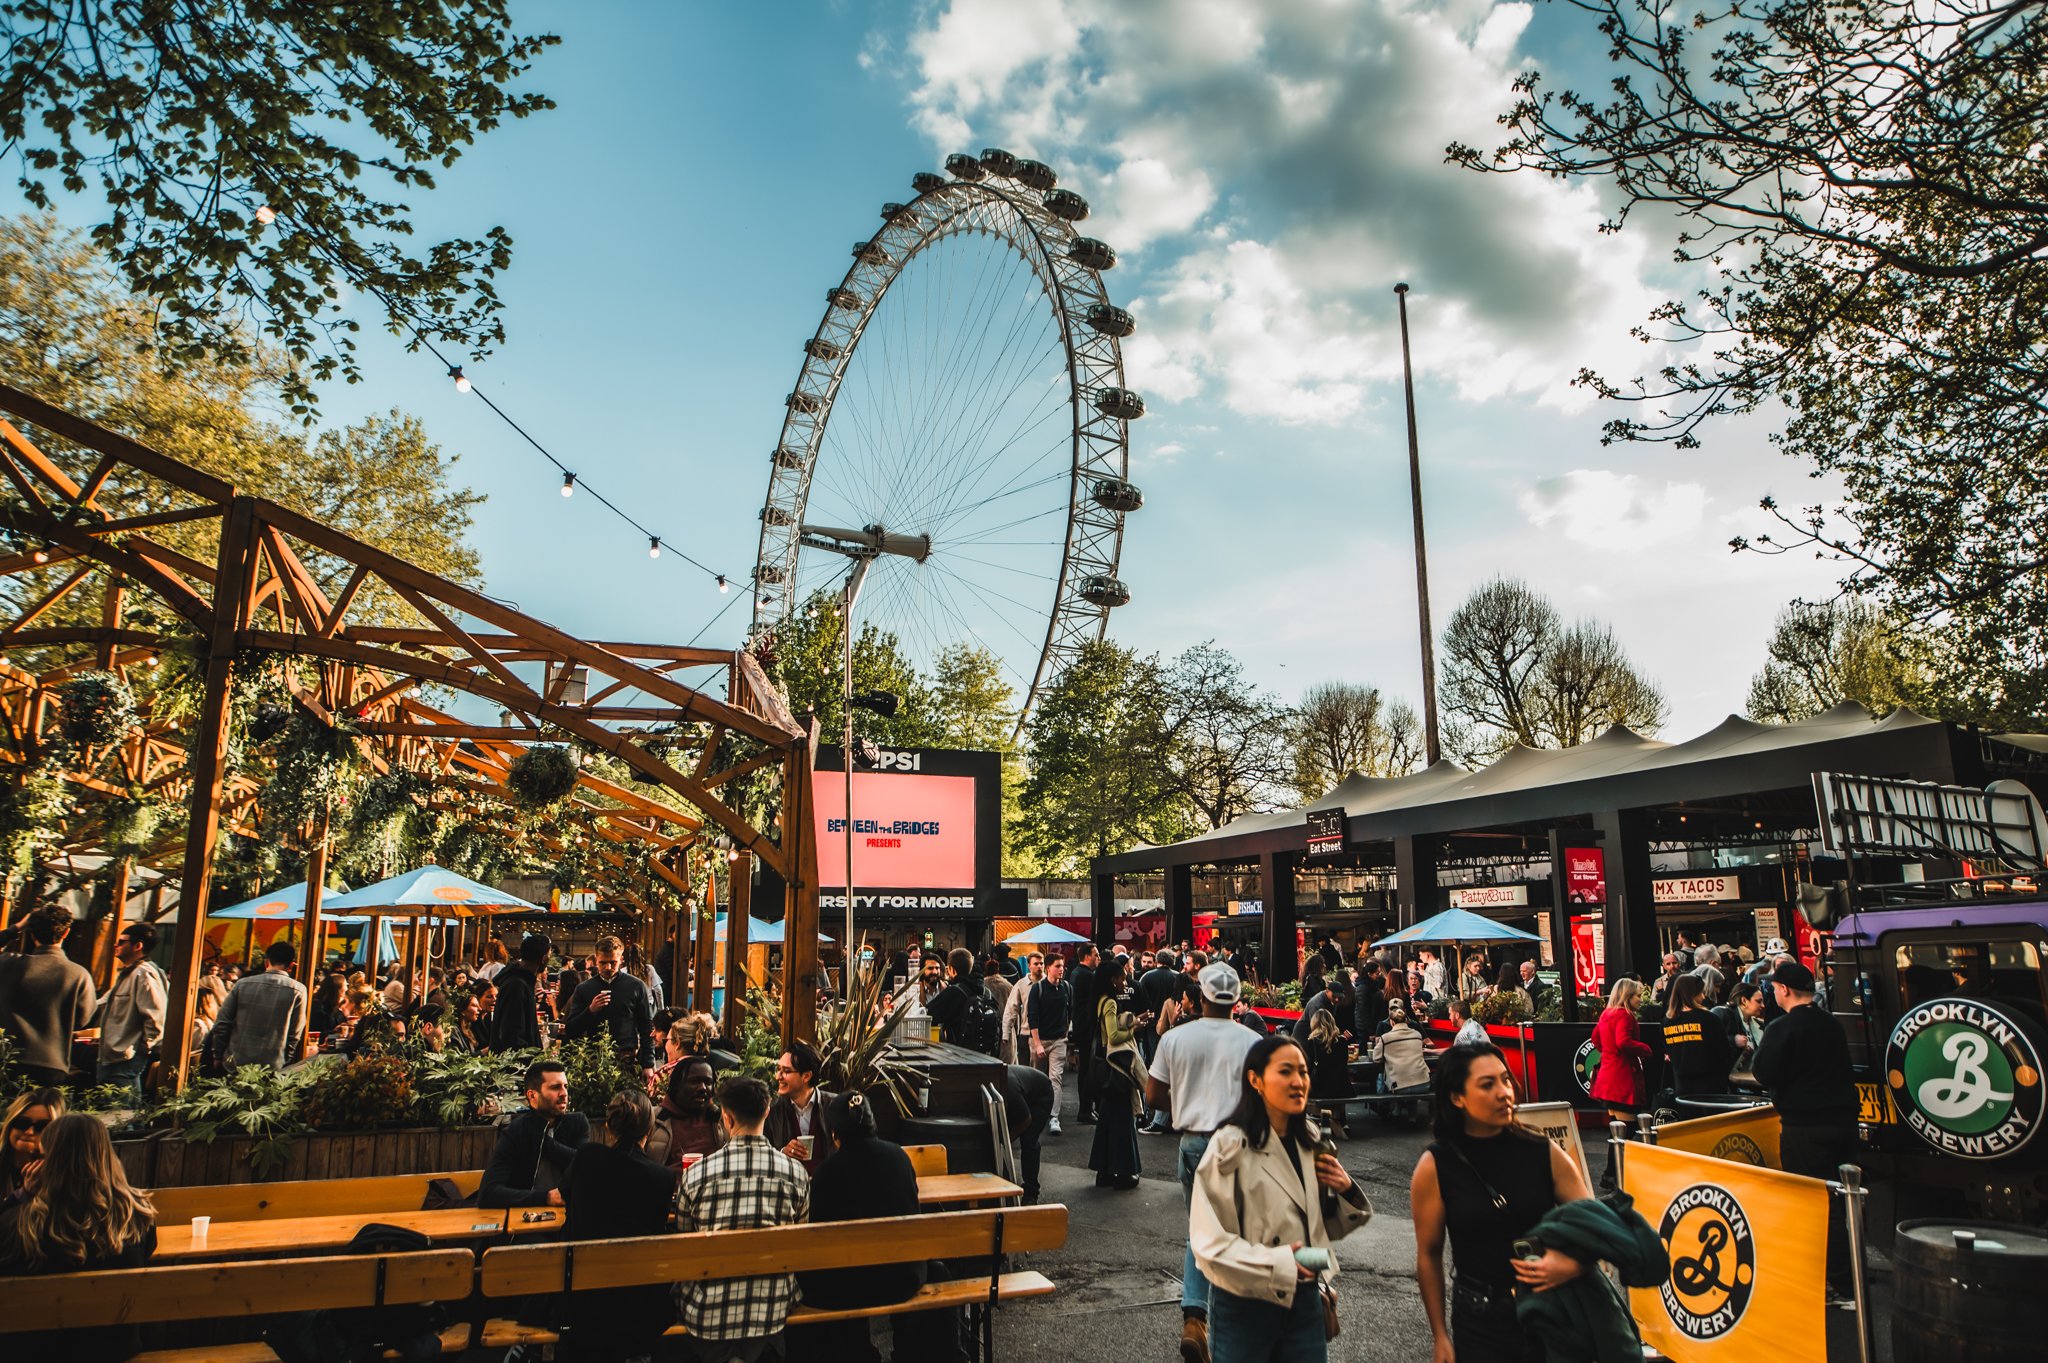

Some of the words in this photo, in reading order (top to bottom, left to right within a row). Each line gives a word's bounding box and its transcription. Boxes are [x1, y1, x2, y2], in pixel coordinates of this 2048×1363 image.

[853, 751, 920, 771] PSI
[893, 820, 939, 835] BRIDGES
[866, 838, 901, 848] PRESENTS
[1310, 844, 1320, 854] Eat
[1321, 841, 1341, 853] Street
[1655, 882, 1674, 895] MX
[1680, 879, 1725, 894] TACOS
[559, 892, 597, 911] BAR
[879, 896, 918, 908] FOR
[920, 896, 974, 908] MORE
[1893, 1003, 2015, 1050] BROOKLYN
[1907, 1107, 2030, 1154] BREWERY
[1669, 1188, 1748, 1241] BROOKLYN
[1661, 1279, 1735, 1336] BREWERY
